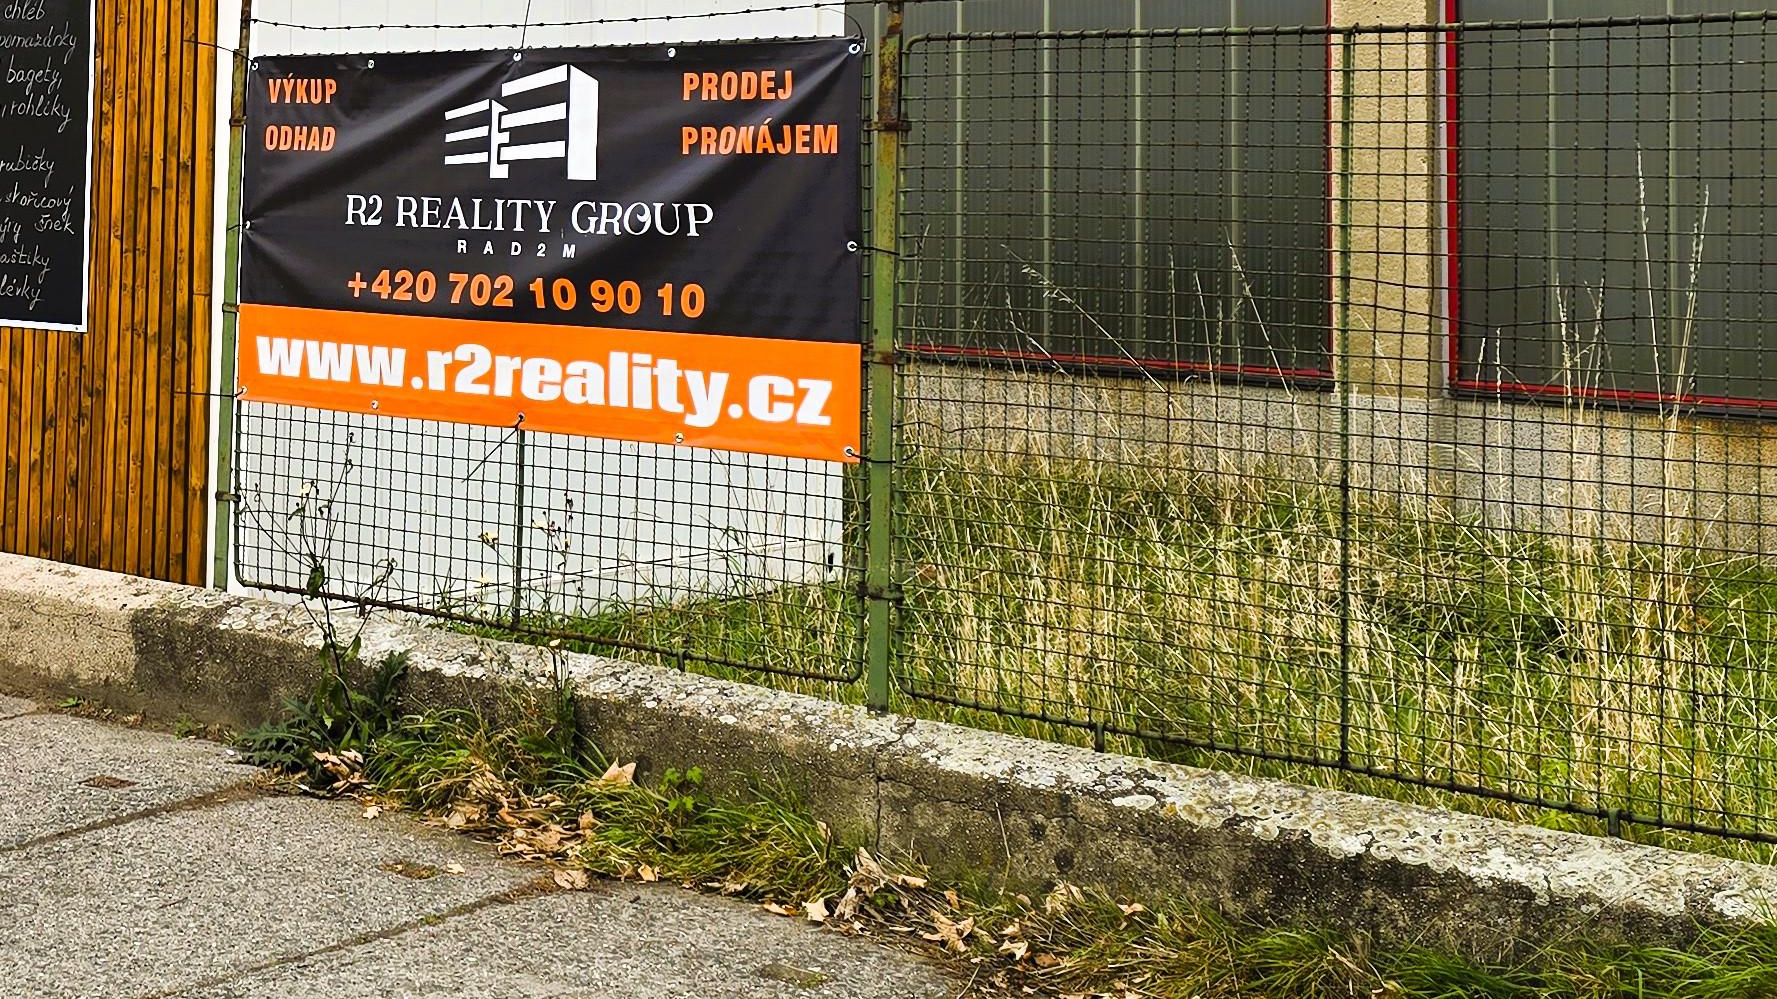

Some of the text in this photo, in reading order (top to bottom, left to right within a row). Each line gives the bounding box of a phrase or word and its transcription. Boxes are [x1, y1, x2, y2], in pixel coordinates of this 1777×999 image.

[268, 73, 337, 104] VÝKUP
[683, 70, 793, 101] PRODEJ
[265, 125, 336, 152] ODHAD
[682, 117, 839, 155] PRONÁJEM
[344, 194, 714, 237] R2 REALITY GROUP
[347, 269, 705, 318] +420 702 10 90 10
[255, 334, 833, 428] www.r2reality.cz
